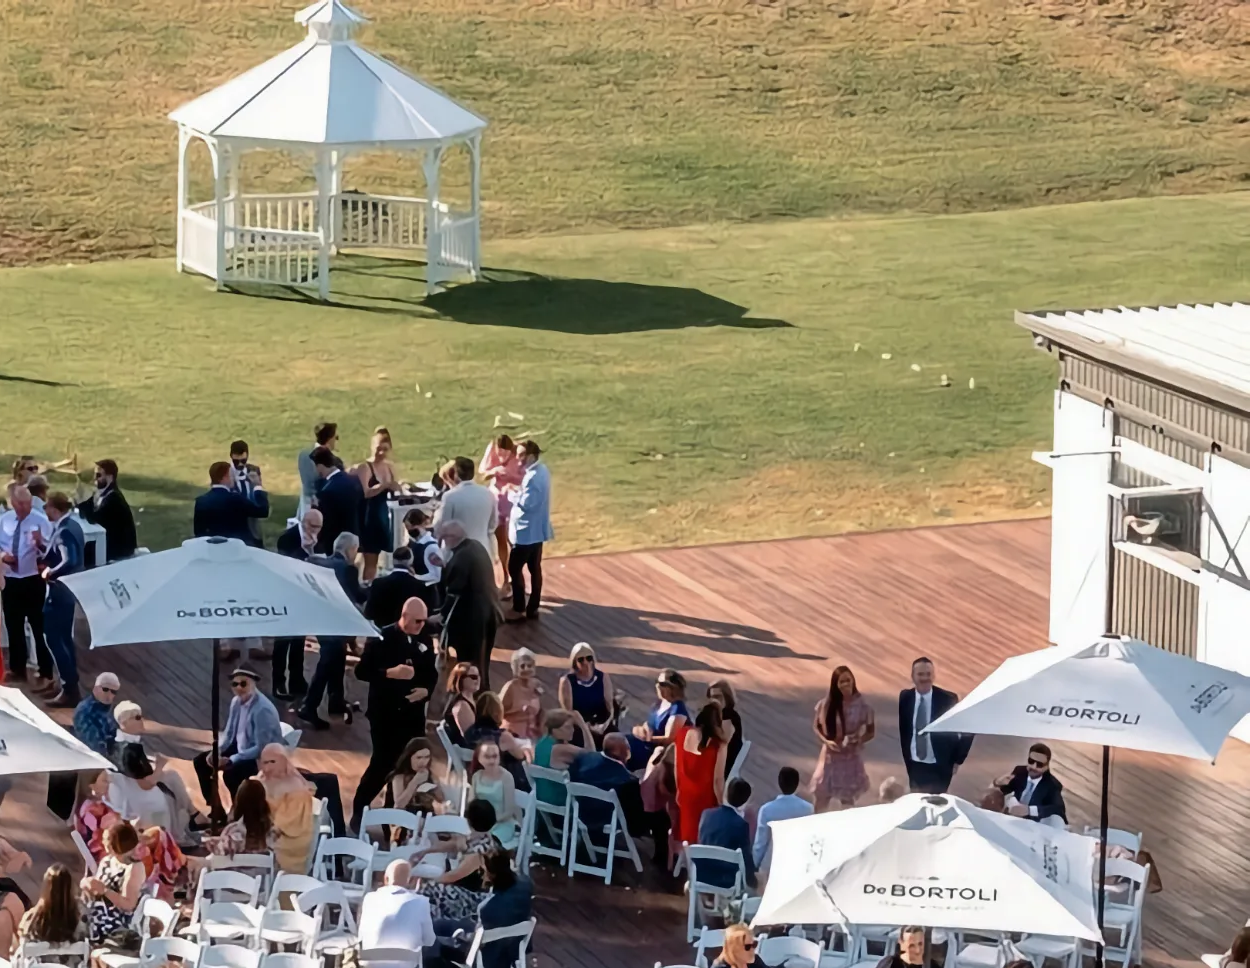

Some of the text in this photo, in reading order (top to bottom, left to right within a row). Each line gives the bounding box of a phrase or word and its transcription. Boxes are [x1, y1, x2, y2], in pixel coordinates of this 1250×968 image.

[199, 606, 288, 618] BORTOLI
[1048, 705, 1140, 725] BORTOLI
[891, 884, 997, 901] BORTOLI
